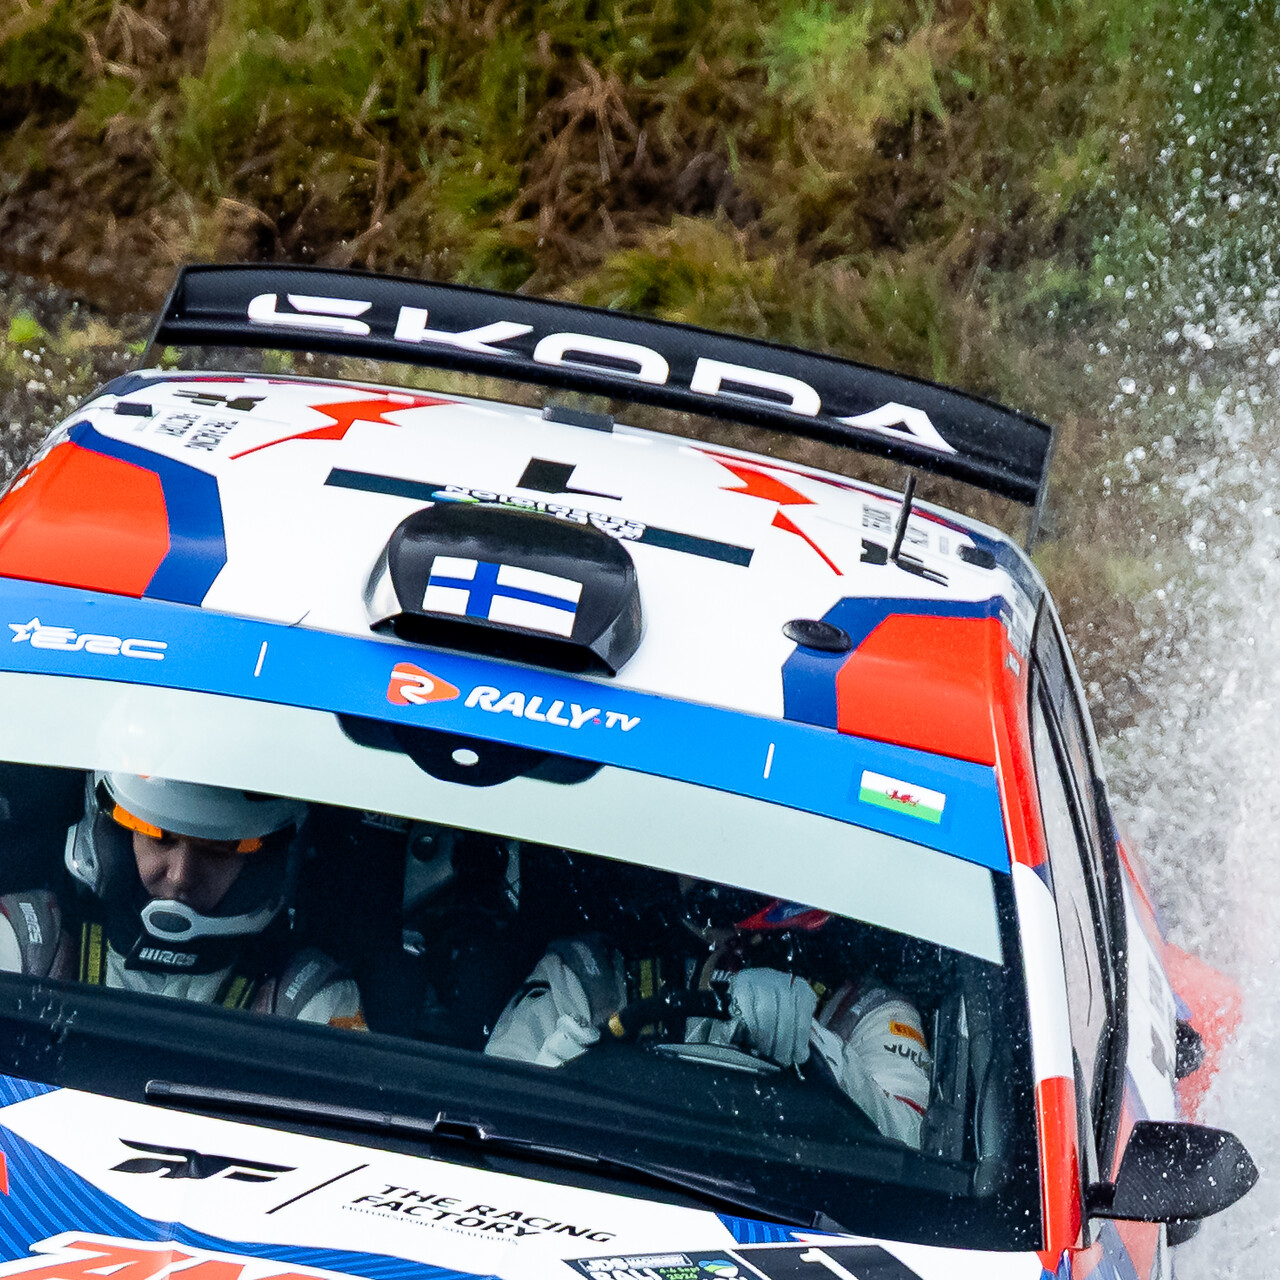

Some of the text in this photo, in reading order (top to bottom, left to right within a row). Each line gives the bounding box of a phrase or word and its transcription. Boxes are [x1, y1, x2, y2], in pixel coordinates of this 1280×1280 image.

[30, 626, 168, 661] ERC
[351, 1195, 542, 1238] FACTORY
[379, 1183, 617, 1243] THE RACING
